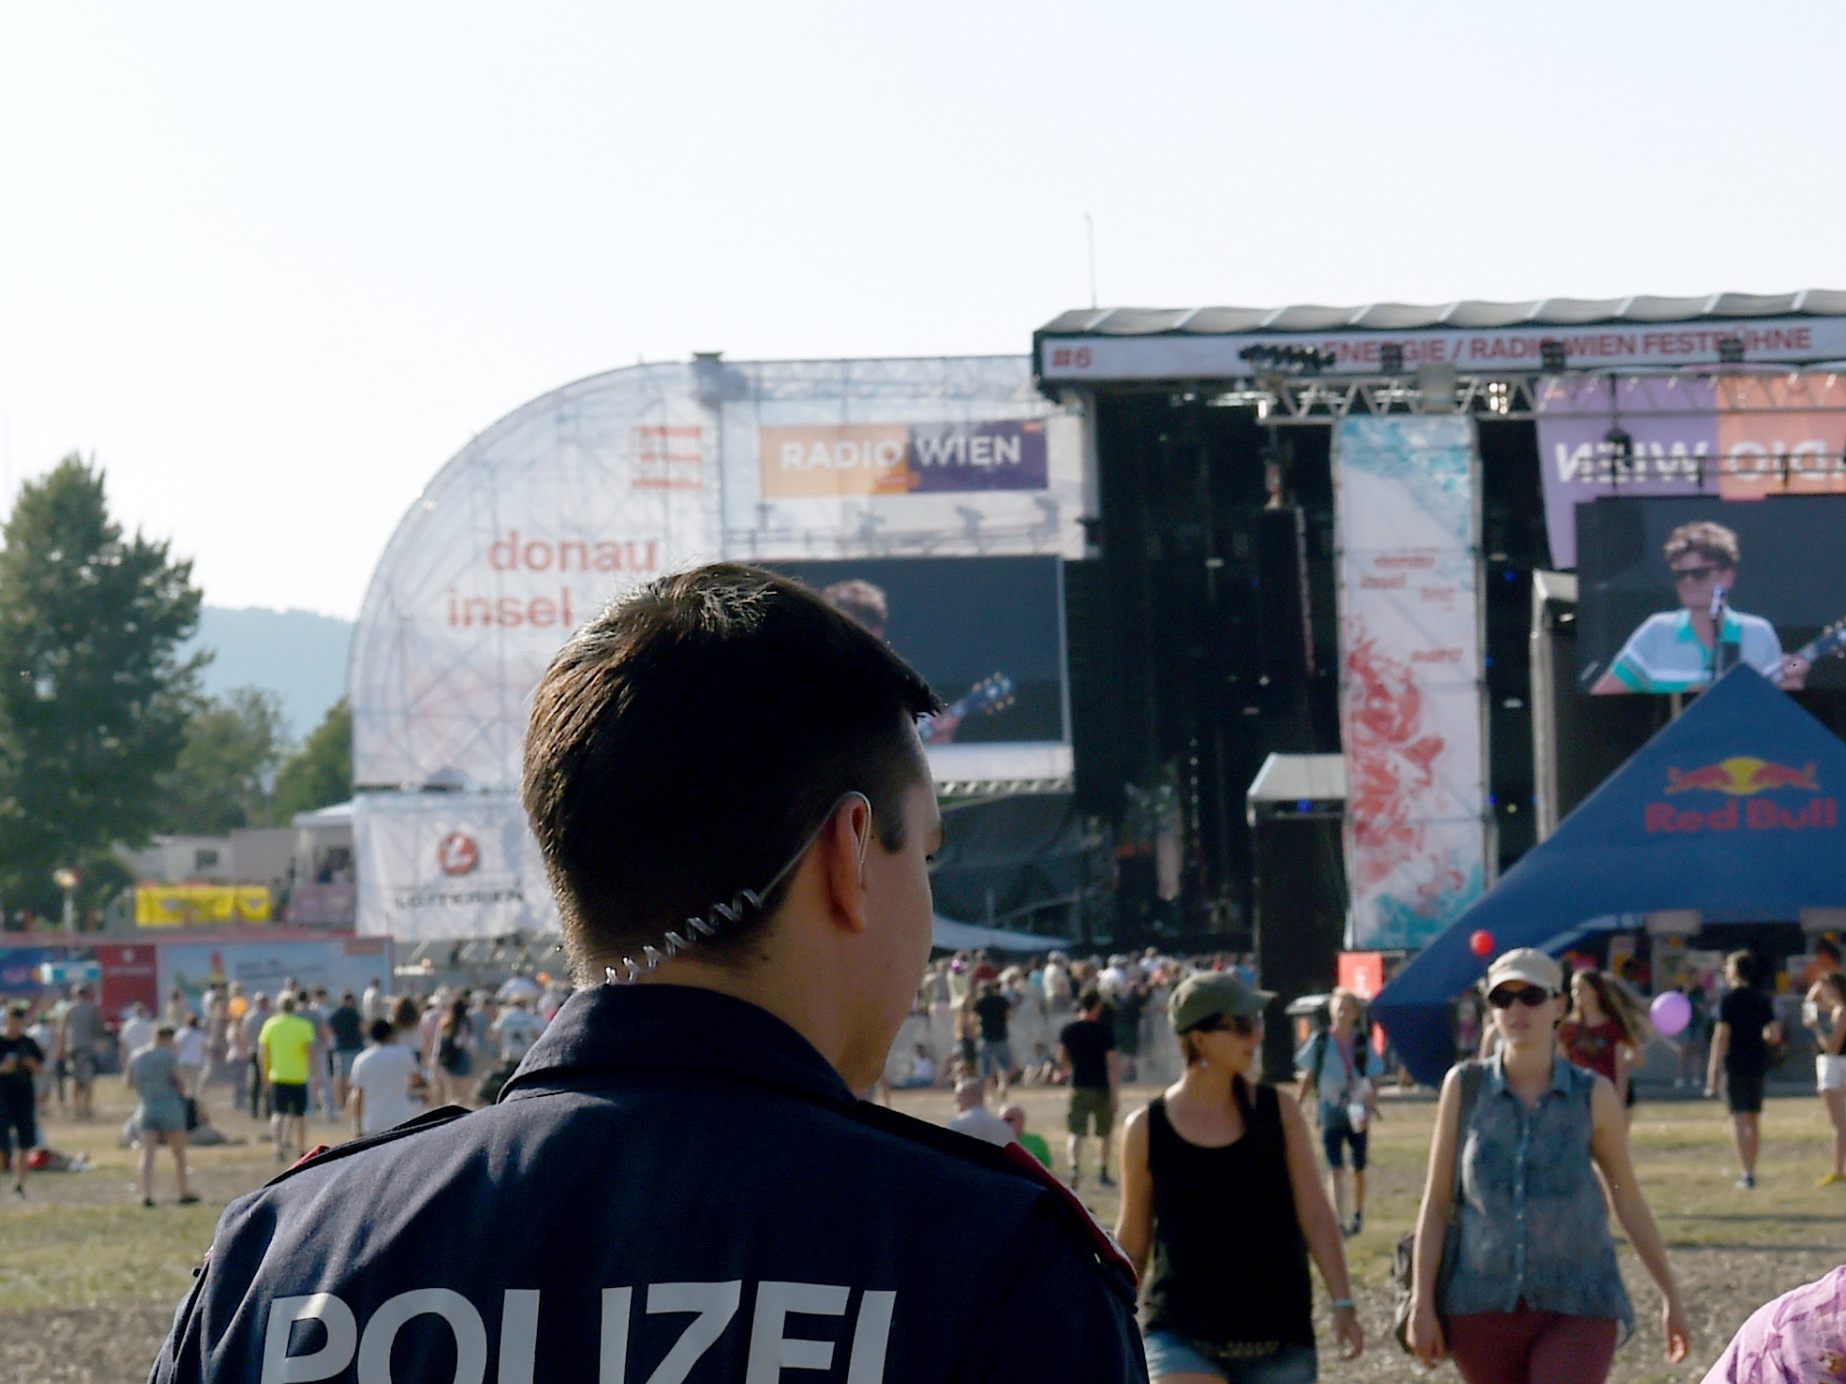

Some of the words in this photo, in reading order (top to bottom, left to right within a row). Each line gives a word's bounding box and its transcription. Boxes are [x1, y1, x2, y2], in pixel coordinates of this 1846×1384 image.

[1053, 346, 1093, 368] #6
[781, 438, 902, 471] RADIO
[915, 433, 1022, 467] WIEN
[488, 530, 657, 572] donau
[447, 584, 574, 628] insel
[1645, 800, 1739, 833] Red
[1747, 797, 1838, 829] Bull
